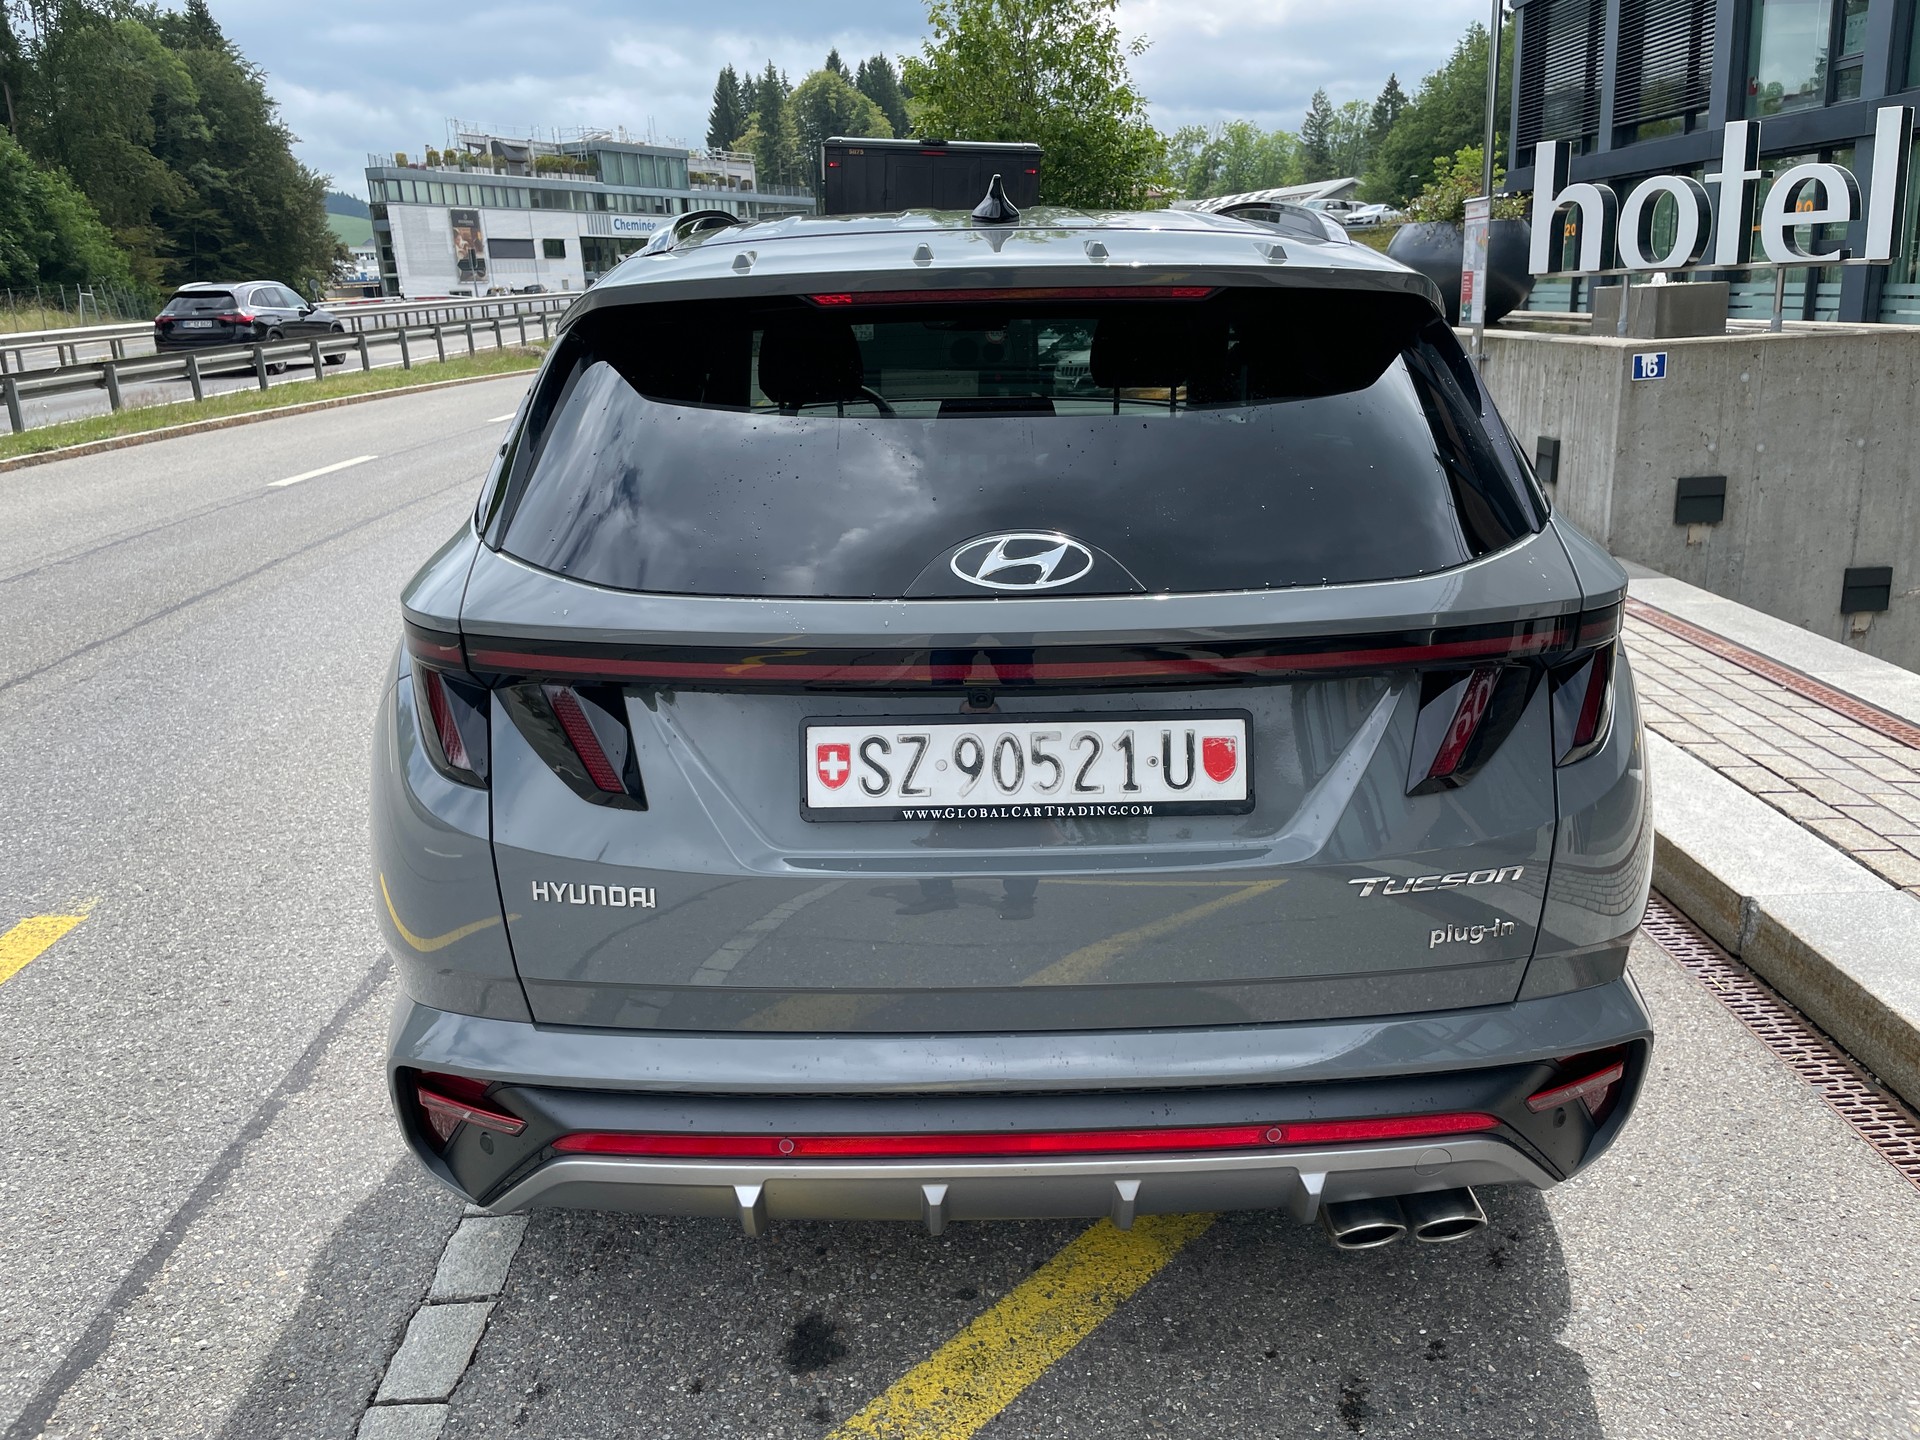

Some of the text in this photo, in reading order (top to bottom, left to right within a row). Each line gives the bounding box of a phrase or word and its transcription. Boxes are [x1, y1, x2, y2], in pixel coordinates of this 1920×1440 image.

[1529, 106, 1910, 274] hotel
[1641, 356, 1658, 377] 16
[858, 729, 1195, 798] SZ 90521 U
[532, 880, 656, 908] HYUNDAI
[1429, 918, 1515, 949] plug-in
